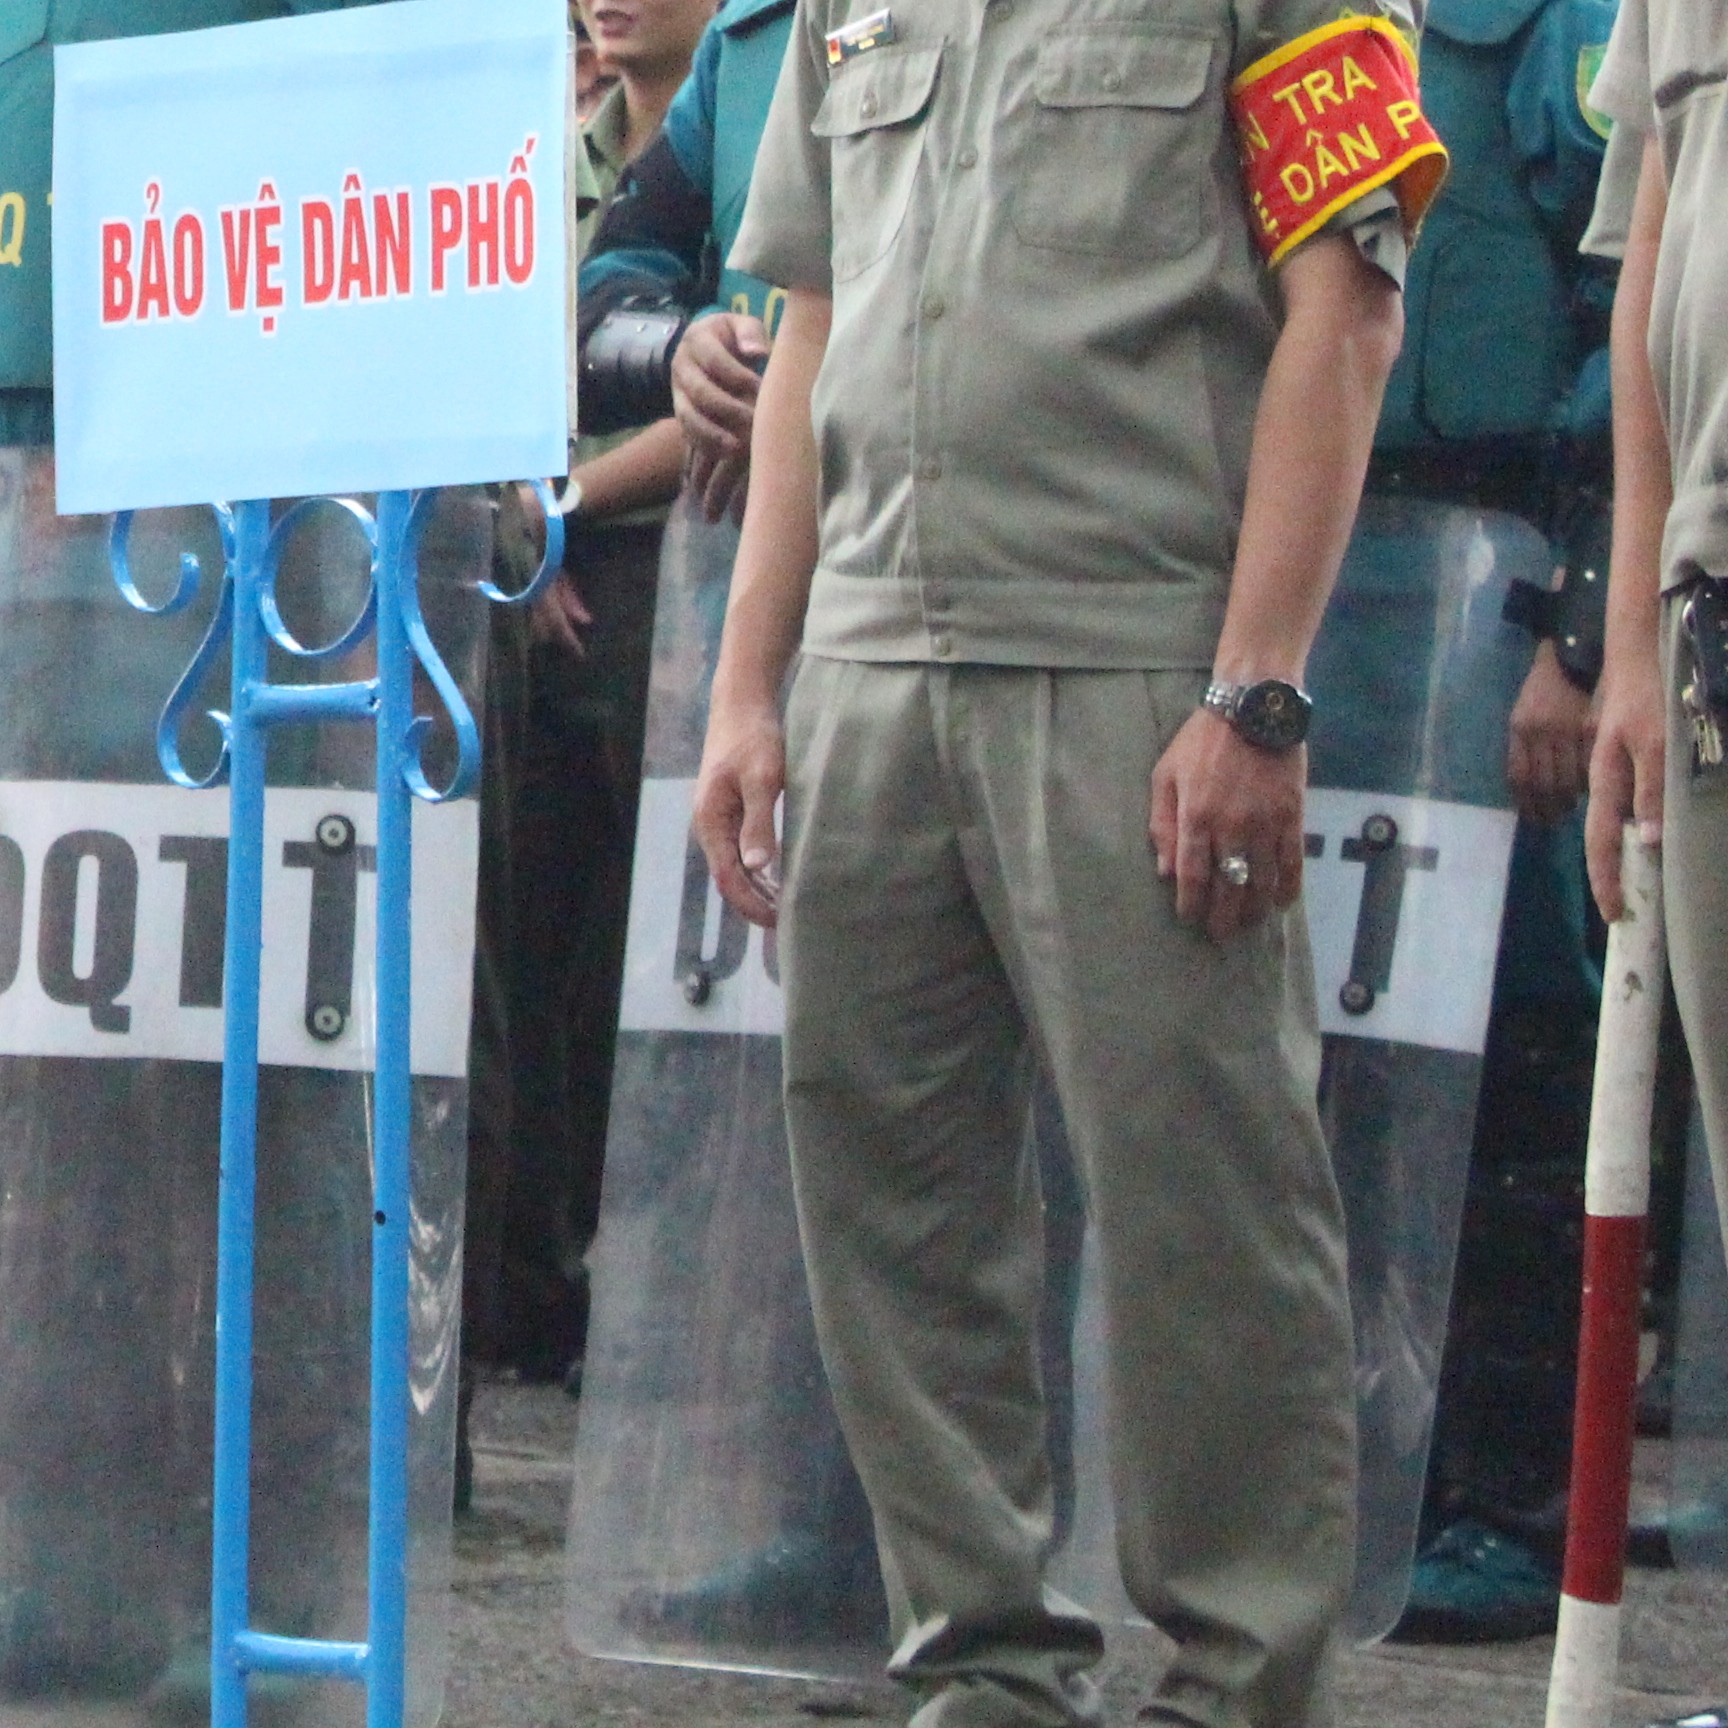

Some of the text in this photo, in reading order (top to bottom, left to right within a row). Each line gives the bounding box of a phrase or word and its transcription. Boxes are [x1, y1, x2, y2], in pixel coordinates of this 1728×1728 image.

[1272, 55, 1378, 125] TRA
[1279, 123, 1381, 204] DÂN
[101, 138, 537, 332] BẢO VỆ DÂN PHỐ
